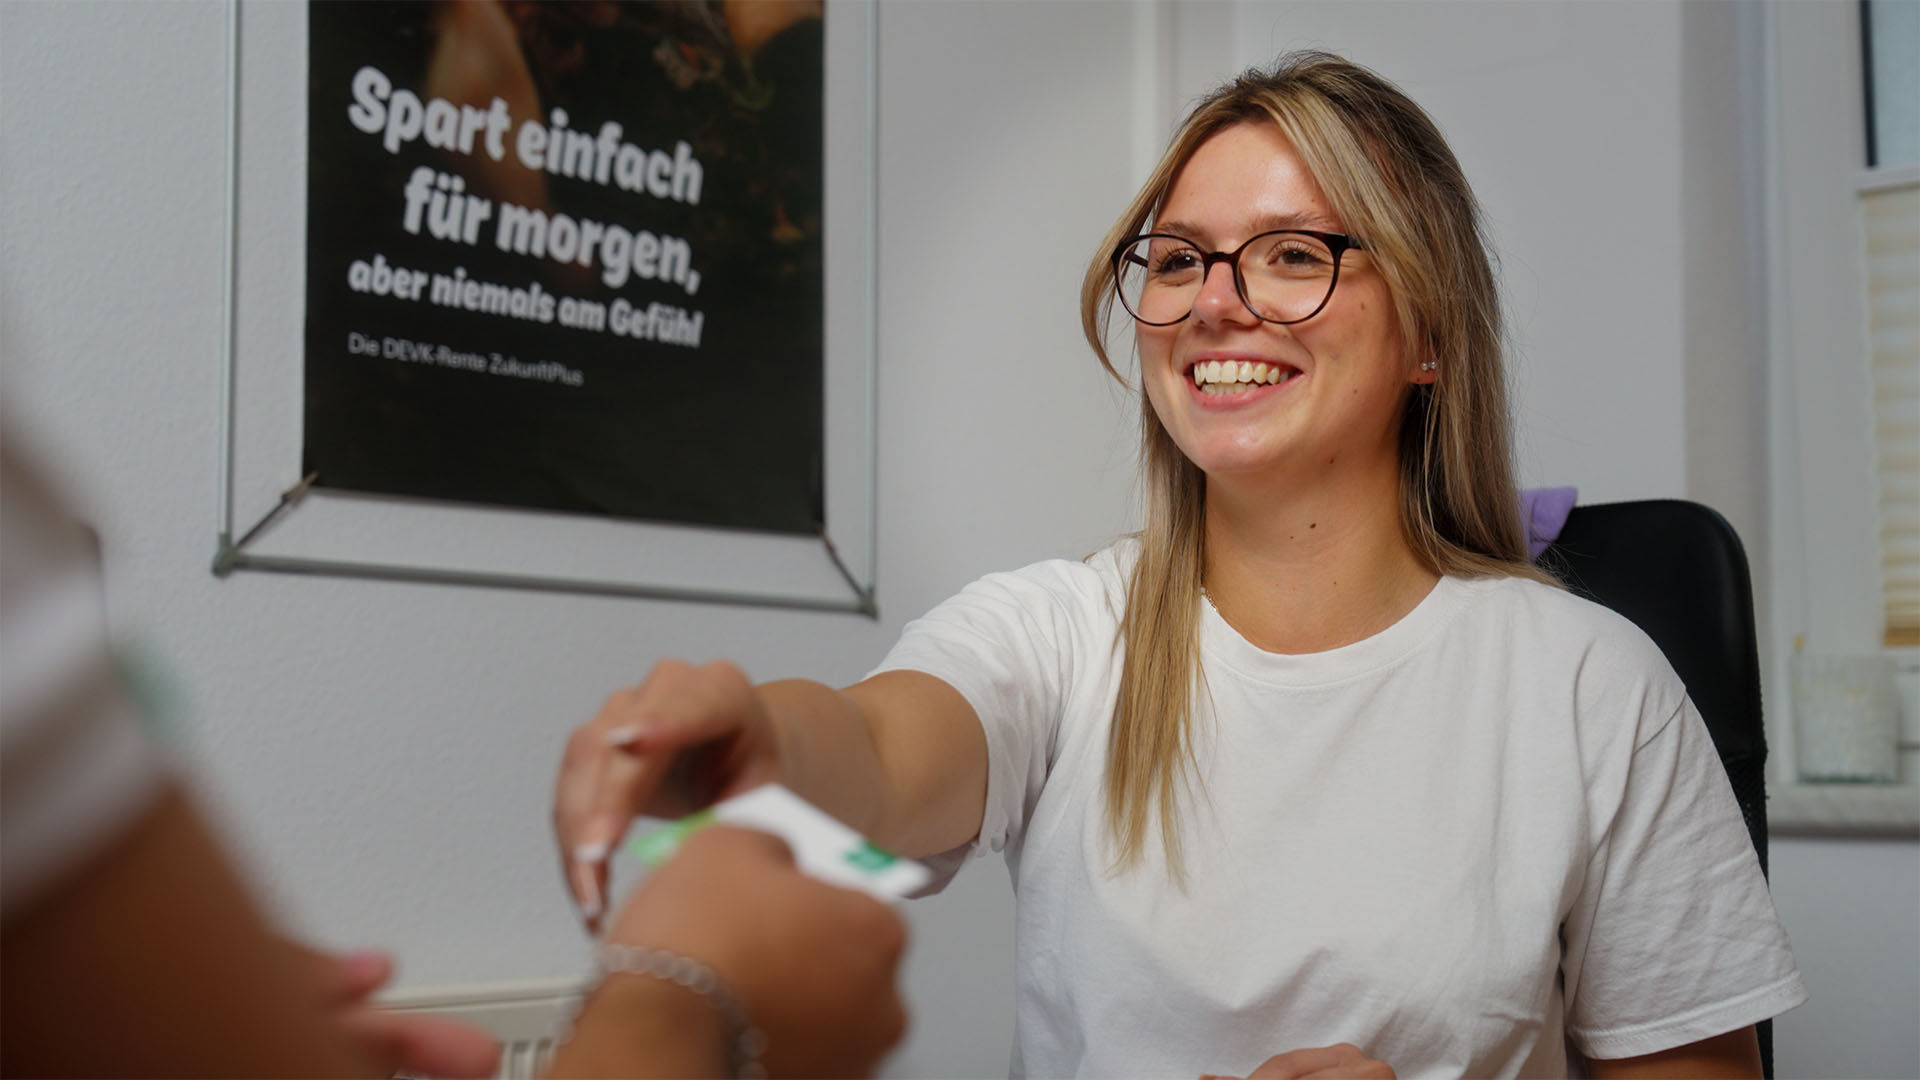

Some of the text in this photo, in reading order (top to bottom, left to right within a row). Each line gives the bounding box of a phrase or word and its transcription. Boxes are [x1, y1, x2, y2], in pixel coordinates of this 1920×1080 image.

[348, 65, 703, 204] Spart einfach
[403, 166, 701, 294] für morgen,
[348, 254, 703, 347] aber niemals am Gefühl
[348, 332, 380, 357] Die
[382, 336, 487, 372] DEVK-Rente
